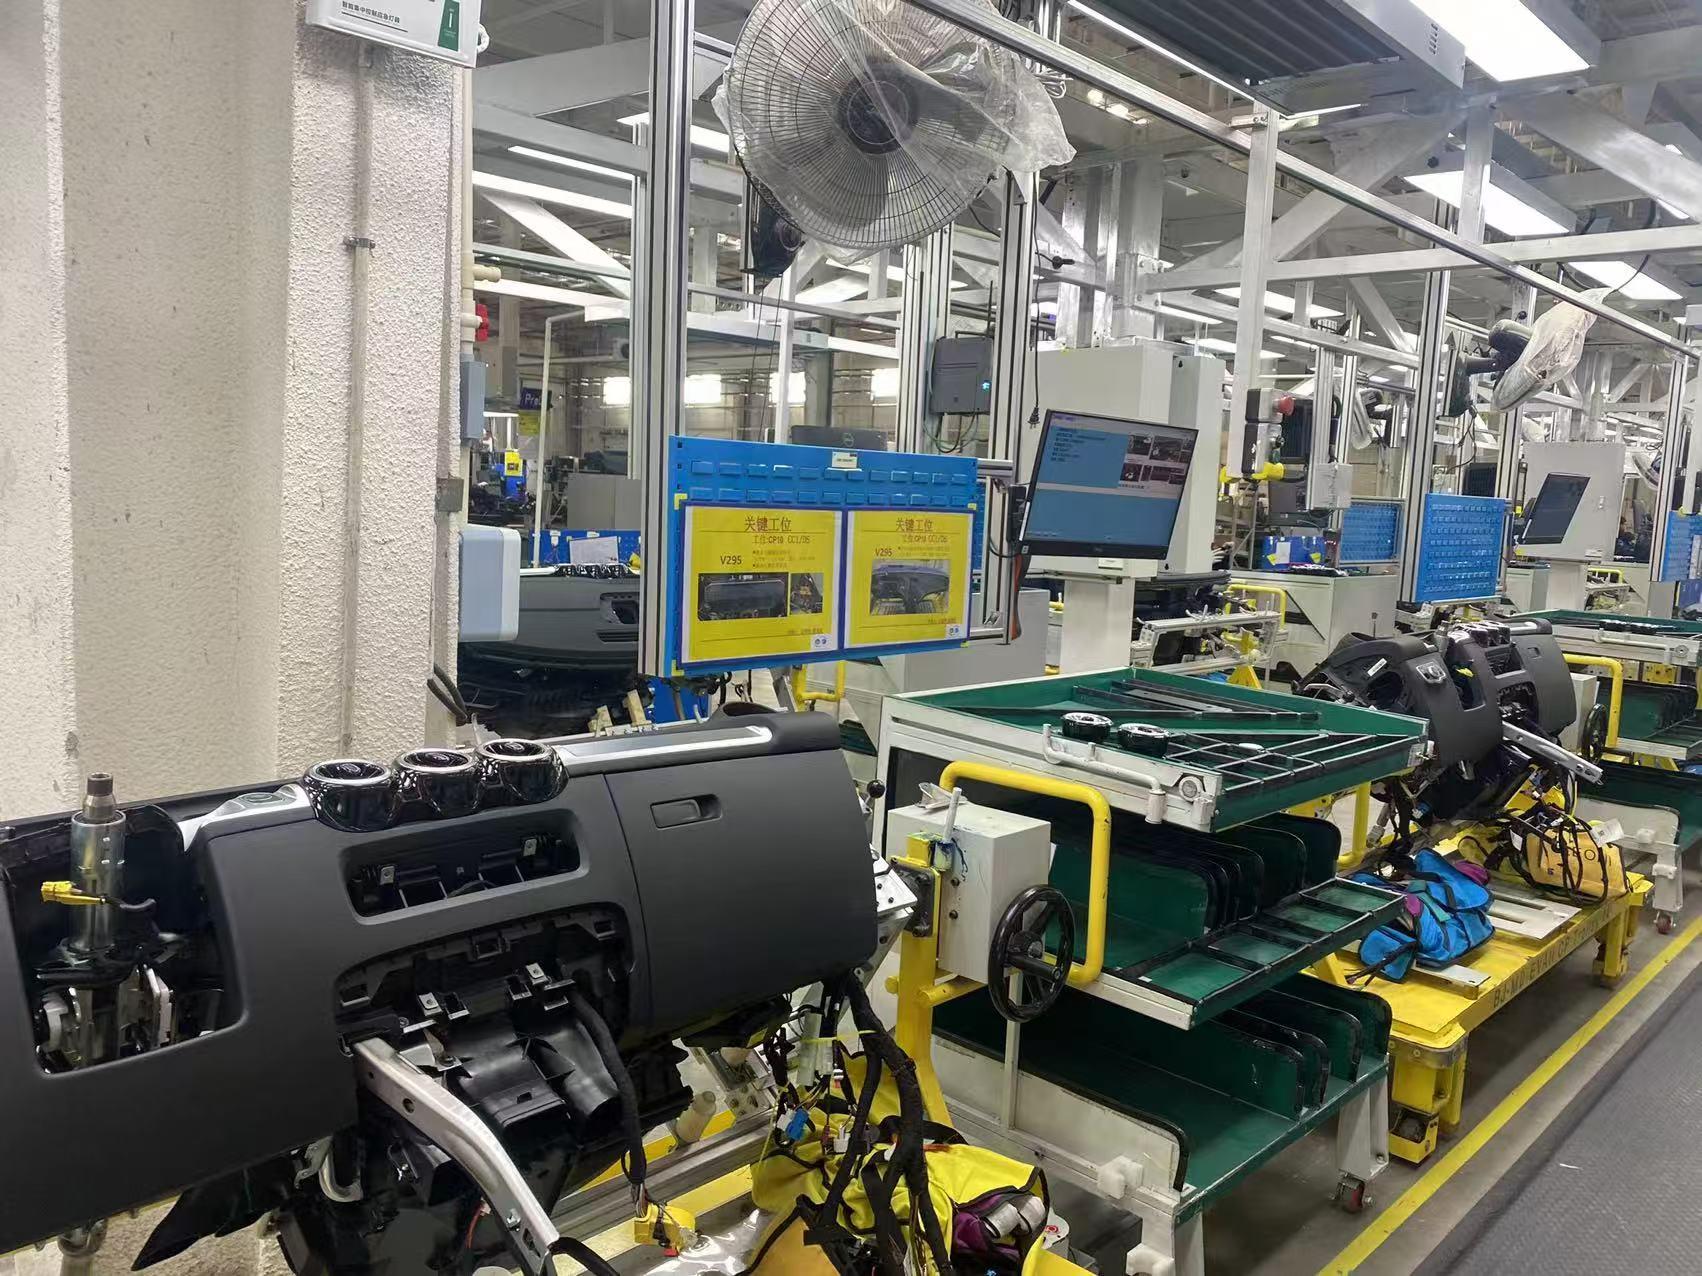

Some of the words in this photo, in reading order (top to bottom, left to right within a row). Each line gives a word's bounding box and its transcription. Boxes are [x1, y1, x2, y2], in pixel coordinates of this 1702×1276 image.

[744, 515, 792, 532] 关键工位
[895, 517, 934, 532] 关键工位
[875, 548, 893, 557] V295
[720, 555, 742, 566] V295
